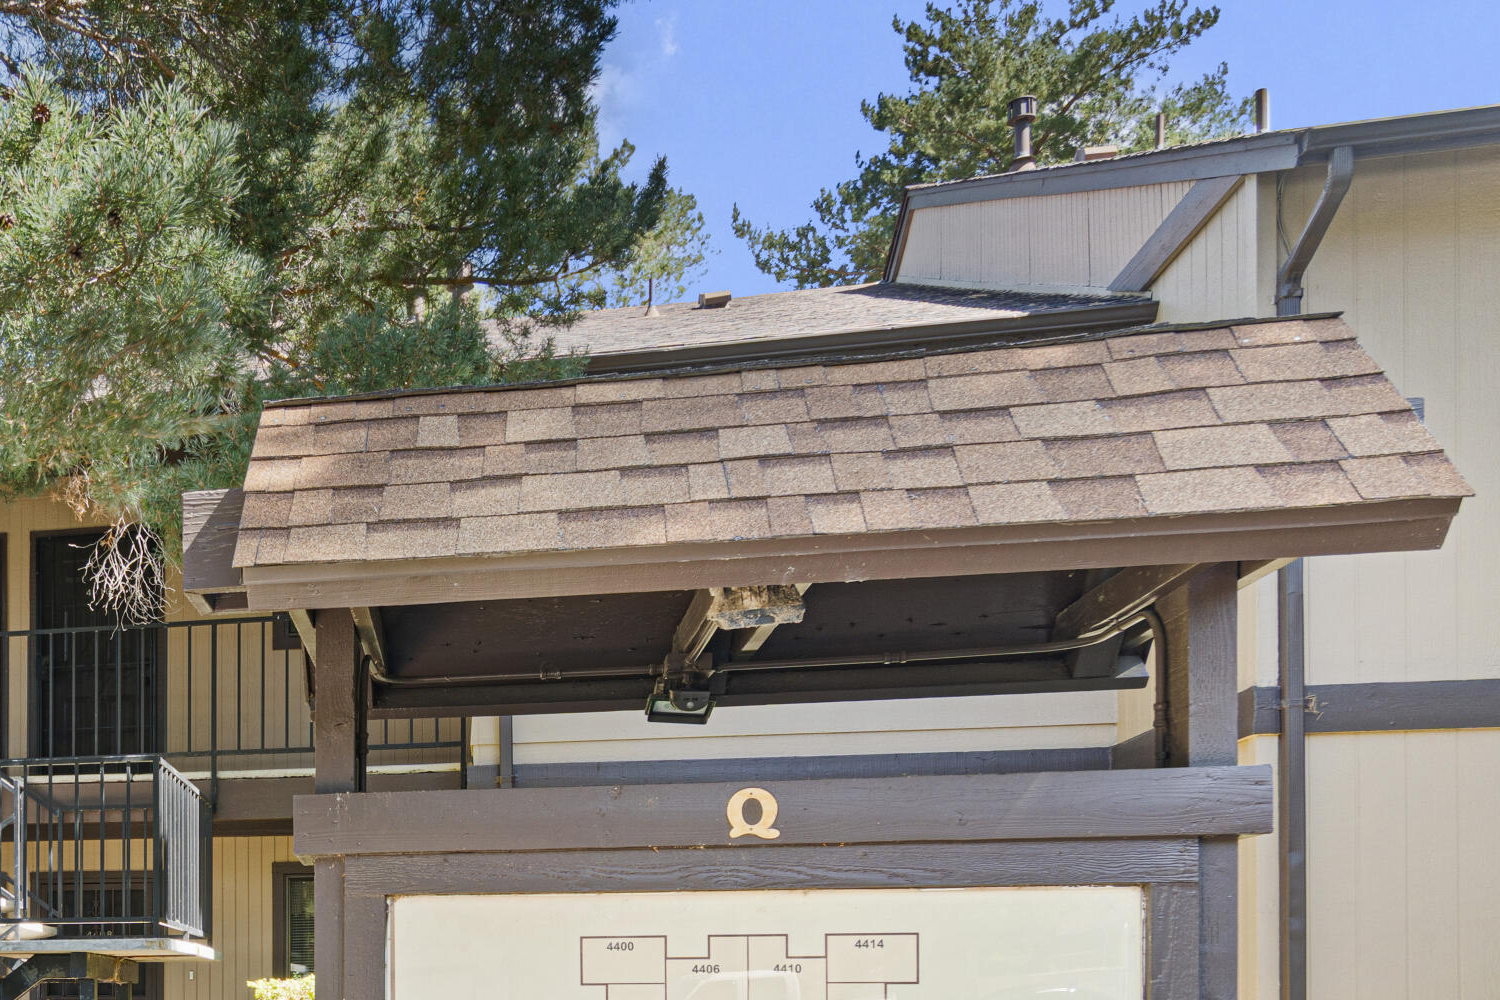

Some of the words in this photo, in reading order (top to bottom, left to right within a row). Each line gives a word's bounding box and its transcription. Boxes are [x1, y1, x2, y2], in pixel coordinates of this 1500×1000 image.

[726, 787, 780, 839] Q
[606, 941, 634, 951] 4400
[854, 939, 885, 949] 4414
[691, 964, 720, 974] 4406
[773, 963, 802, 974] 4410
